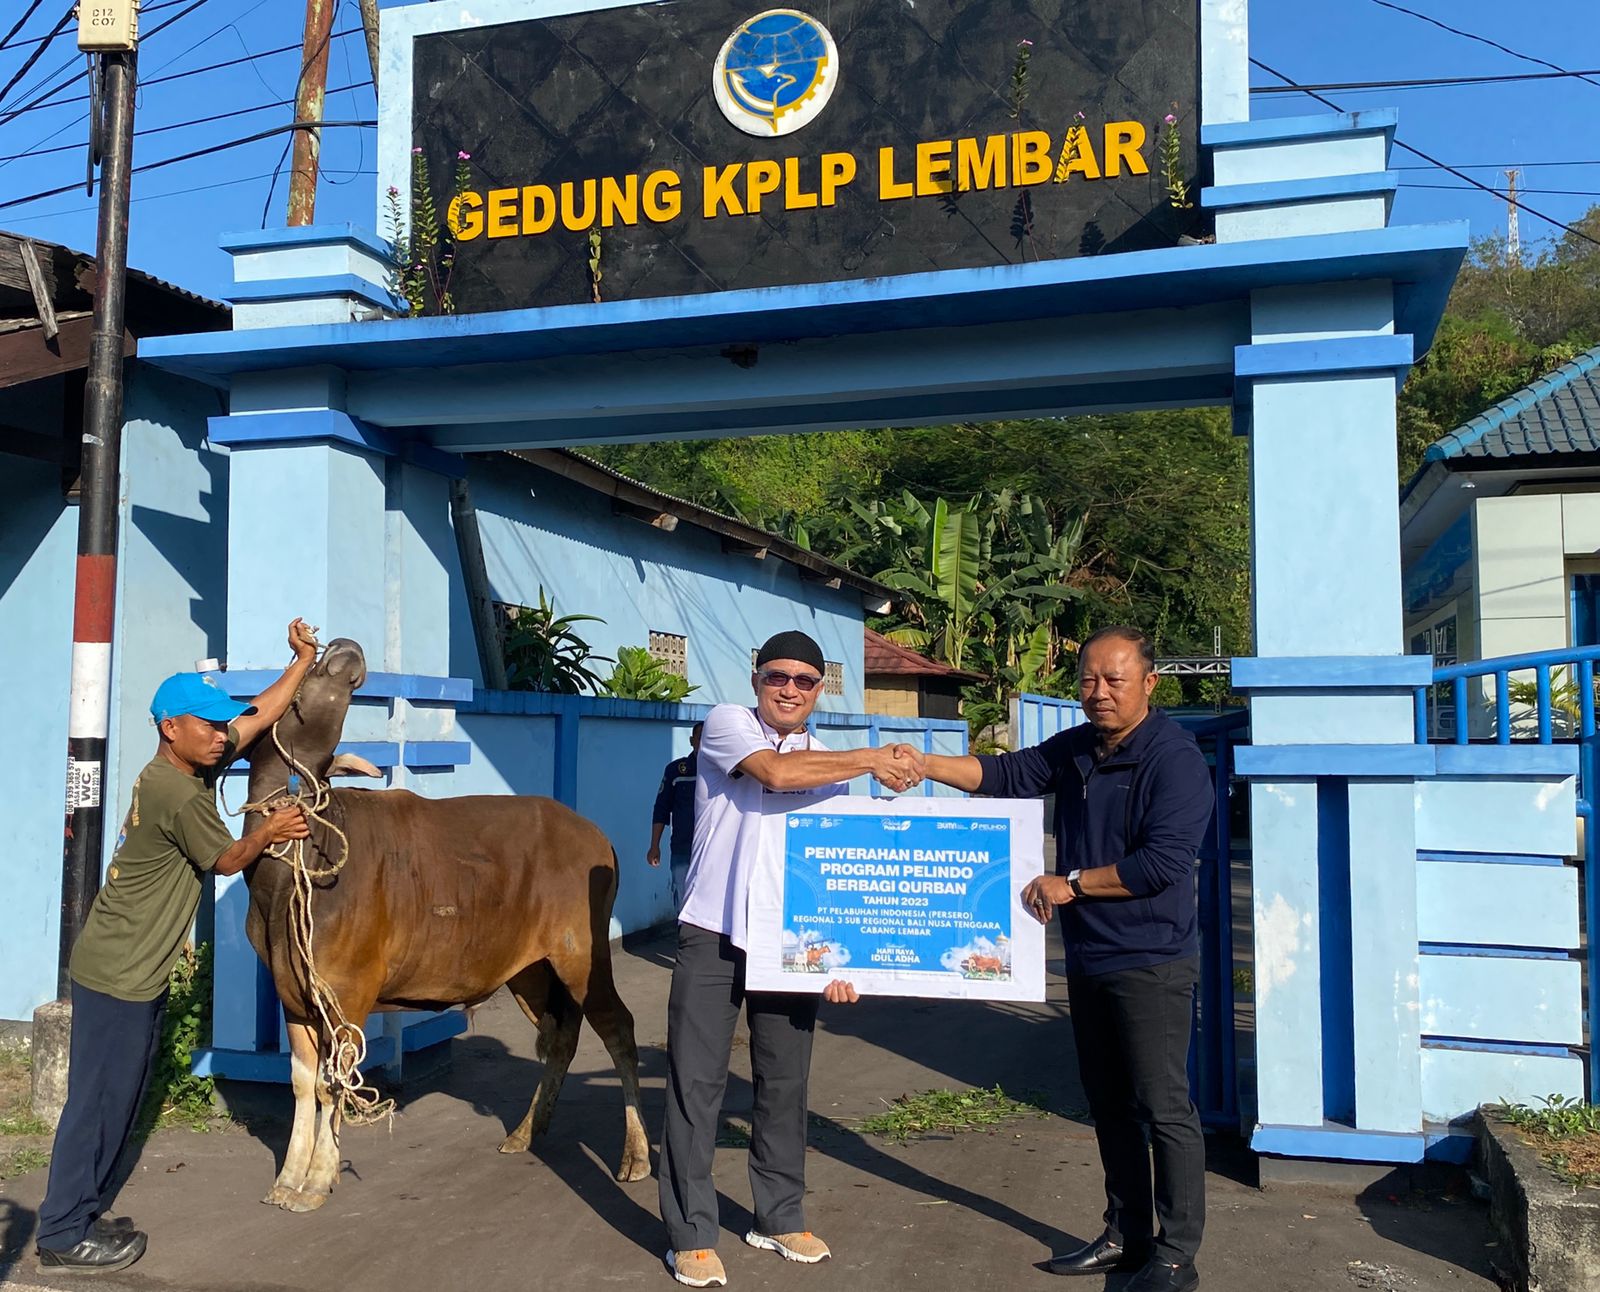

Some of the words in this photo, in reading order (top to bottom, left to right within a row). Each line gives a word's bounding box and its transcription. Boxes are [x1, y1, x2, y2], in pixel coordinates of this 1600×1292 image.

[446, 170, 682, 242] GEDUNG
[703, 151, 857, 219] KPLP
[879, 120, 1149, 200] LEMBAR
[81, 772, 91, 801] WC
[805, 847, 910, 862] PENYERAHAN
[914, 850, 989, 863] BANTUAN
[820, 863, 900, 877] PROGRAM
[904, 866, 973, 879] PELINDO
[826, 879, 895, 892] BERBAGI
[898, 881, 966, 895] QURBAN
[863, 896, 900, 906] TAHUN
[901, 897, 928, 906] 2023
[830, 907, 878, 916] PELABUHAN
[881, 909, 926, 918] INDONESIA
[929, 910, 973, 920] (PERSERO)
[793, 915, 835, 924] REGIONAL
[863, 918, 904, 926] REGIONAL
[928, 920, 951, 928] NUSA
[954, 921, 1000, 929] TENGGARA
[860, 926, 895, 934] CABANG
[898, 928, 931, 936] LEMBAR
[871, 954, 893, 962] IDUL
[895, 955, 920, 963] ADHA
